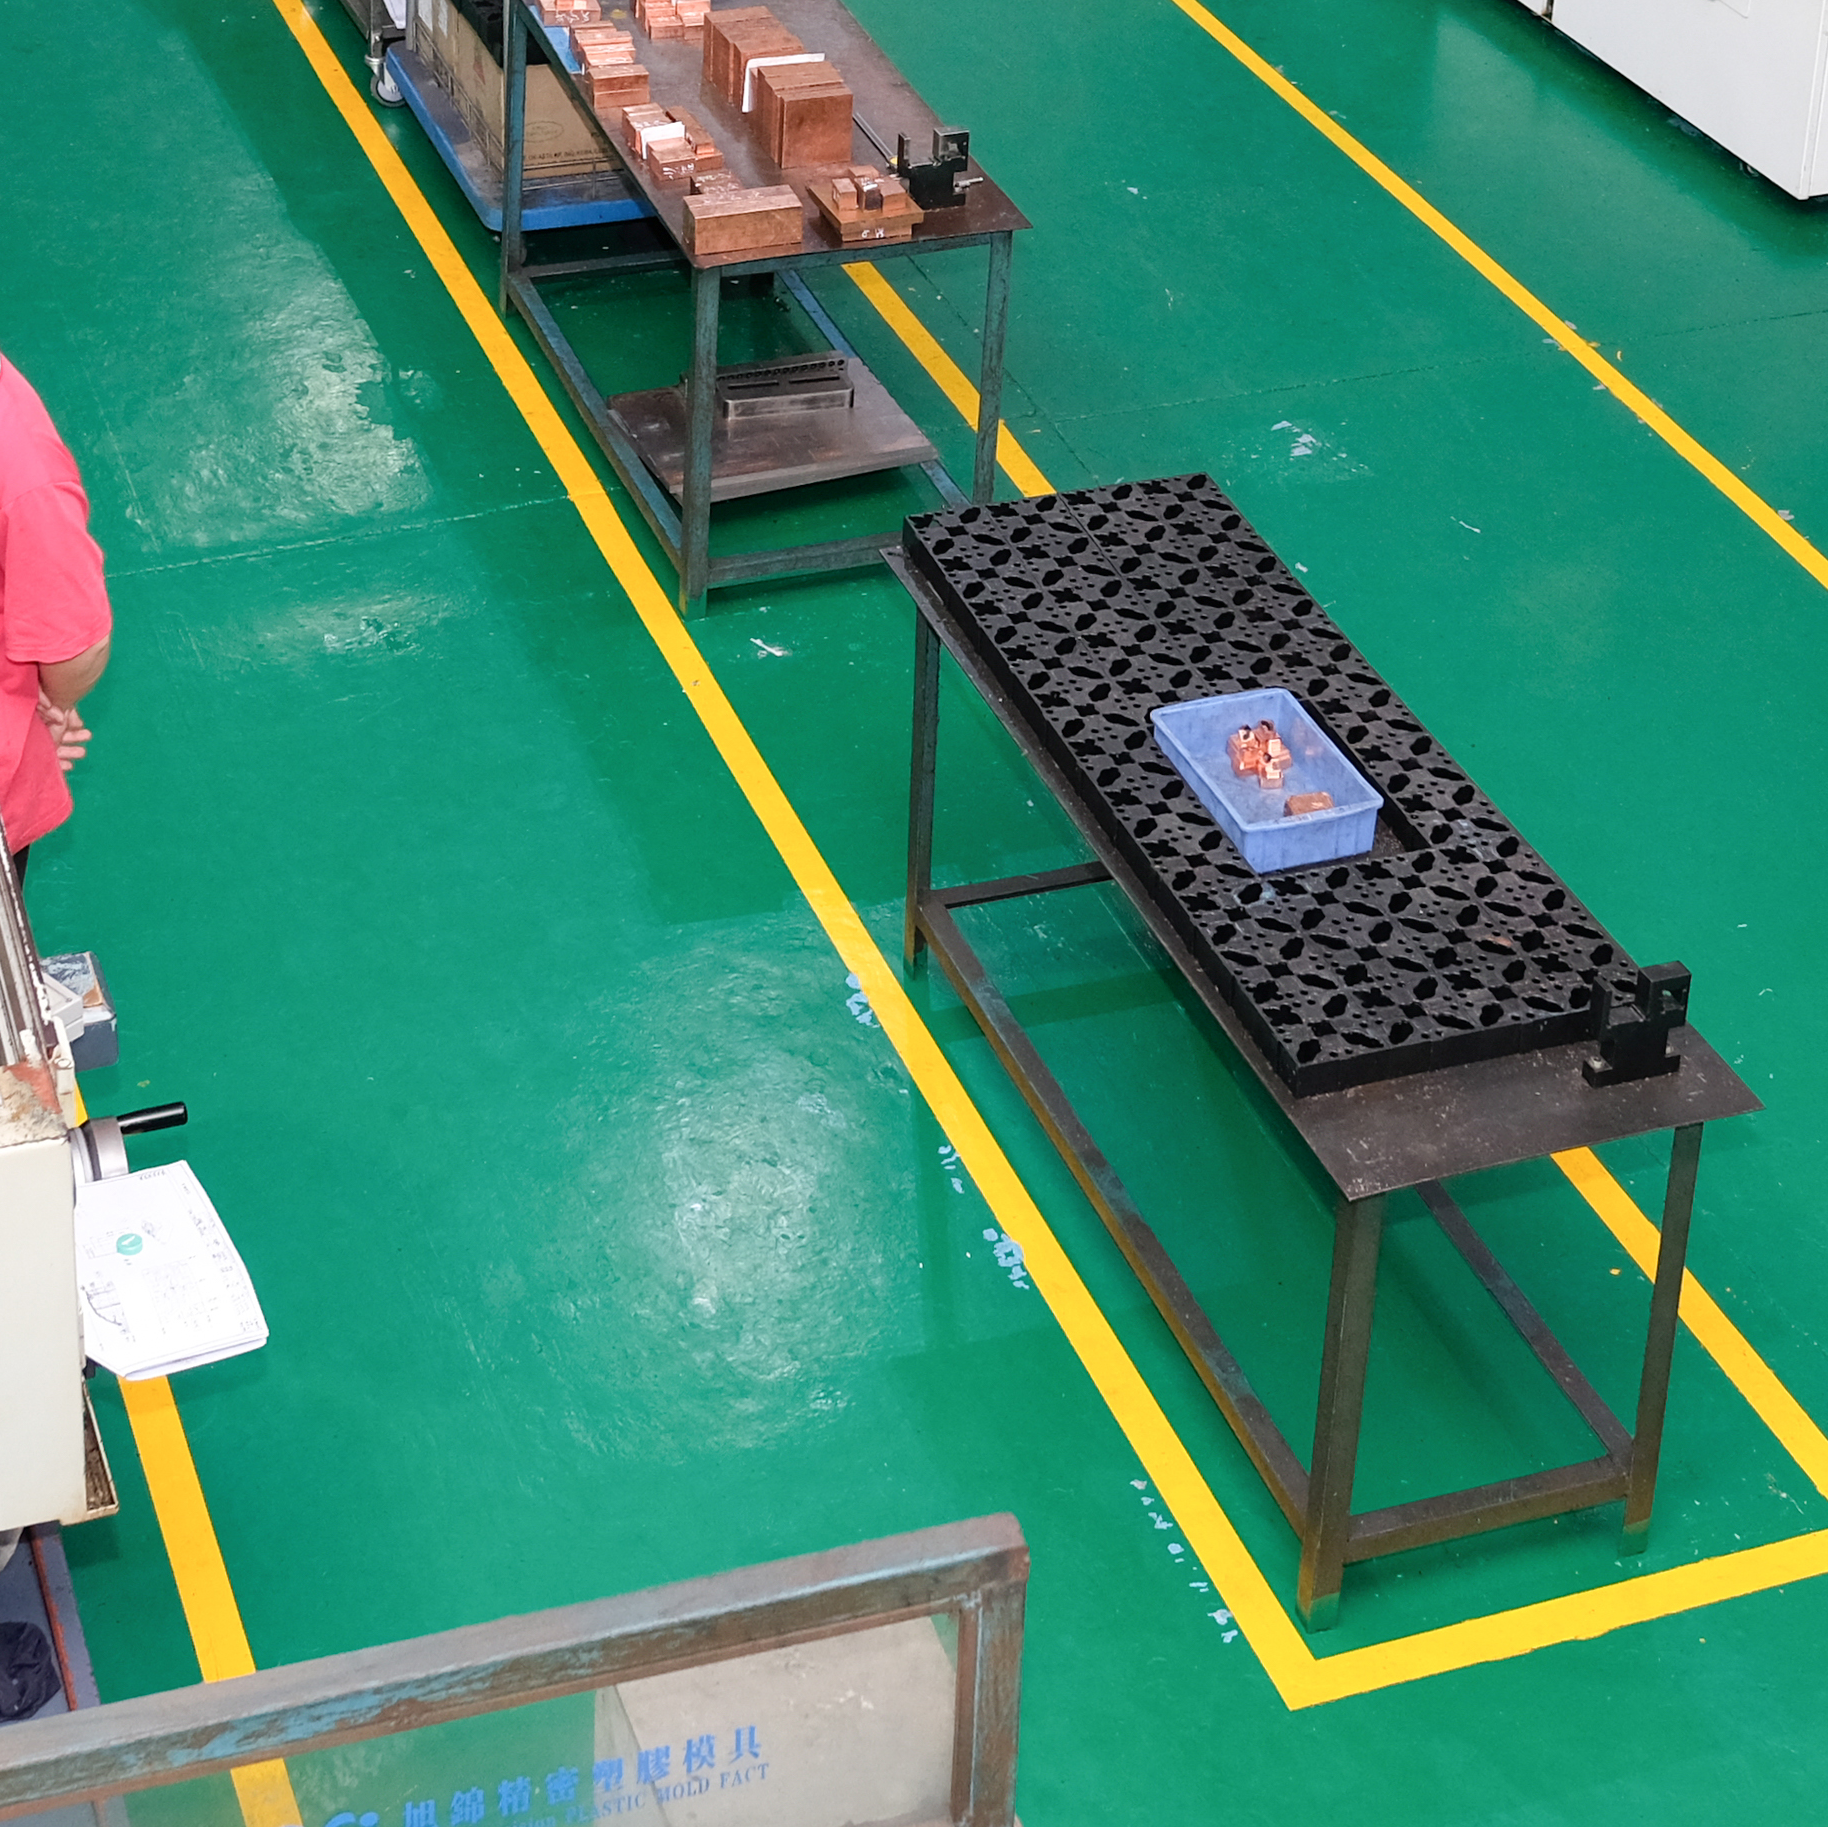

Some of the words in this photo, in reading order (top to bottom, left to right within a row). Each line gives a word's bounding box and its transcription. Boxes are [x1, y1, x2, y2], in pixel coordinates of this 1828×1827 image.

[565, 1792, 646, 1823] PLASTIC
[657, 1776, 711, 1806] MOLD
[719, 1762, 770, 1790] FACT
